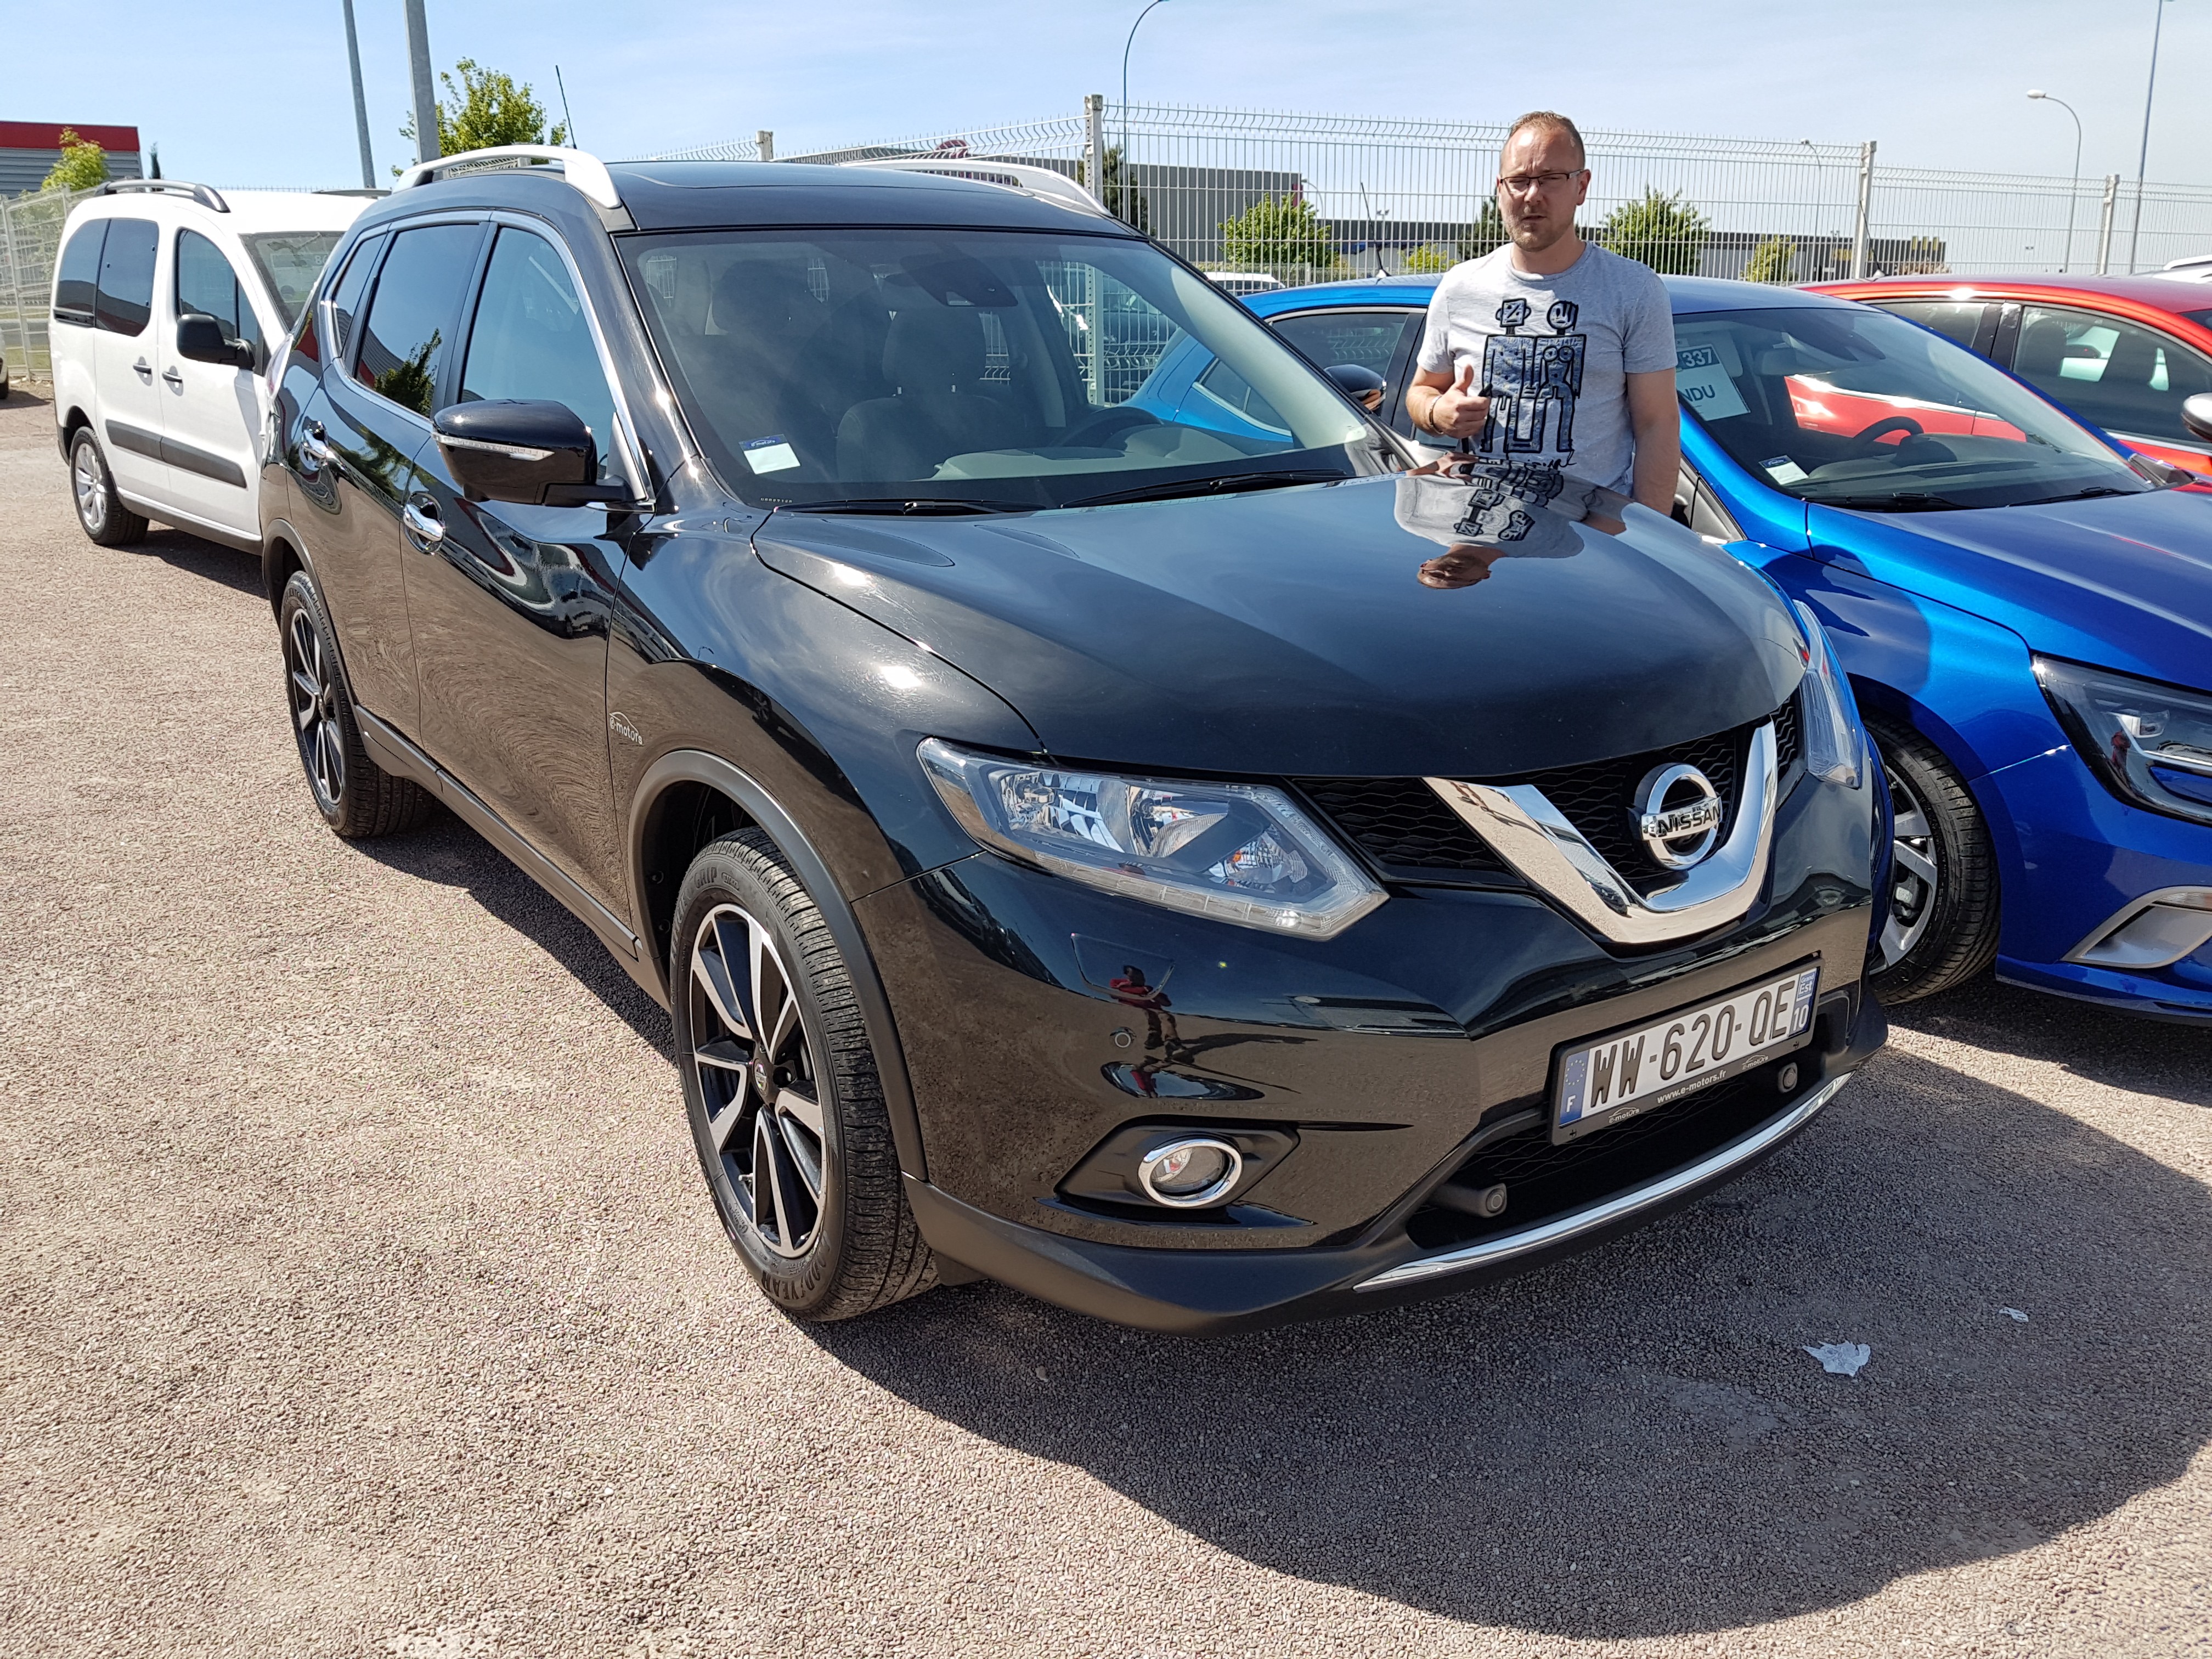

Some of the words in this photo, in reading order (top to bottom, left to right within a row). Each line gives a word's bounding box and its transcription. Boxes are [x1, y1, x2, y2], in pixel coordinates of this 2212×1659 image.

[1682, 348, 1712, 367] 337
[1684, 385, 1716, 402] NDU
[1658, 803, 1720, 834] NISSAN
[1801, 973, 1815, 983] Grand
[1799, 980, 1813, 995] Est
[1793, 1004, 1809, 1031] 10
[1657, 1070, 1726, 1104] www.e-motors.fr
[1566, 1095, 1576, 1113] F
